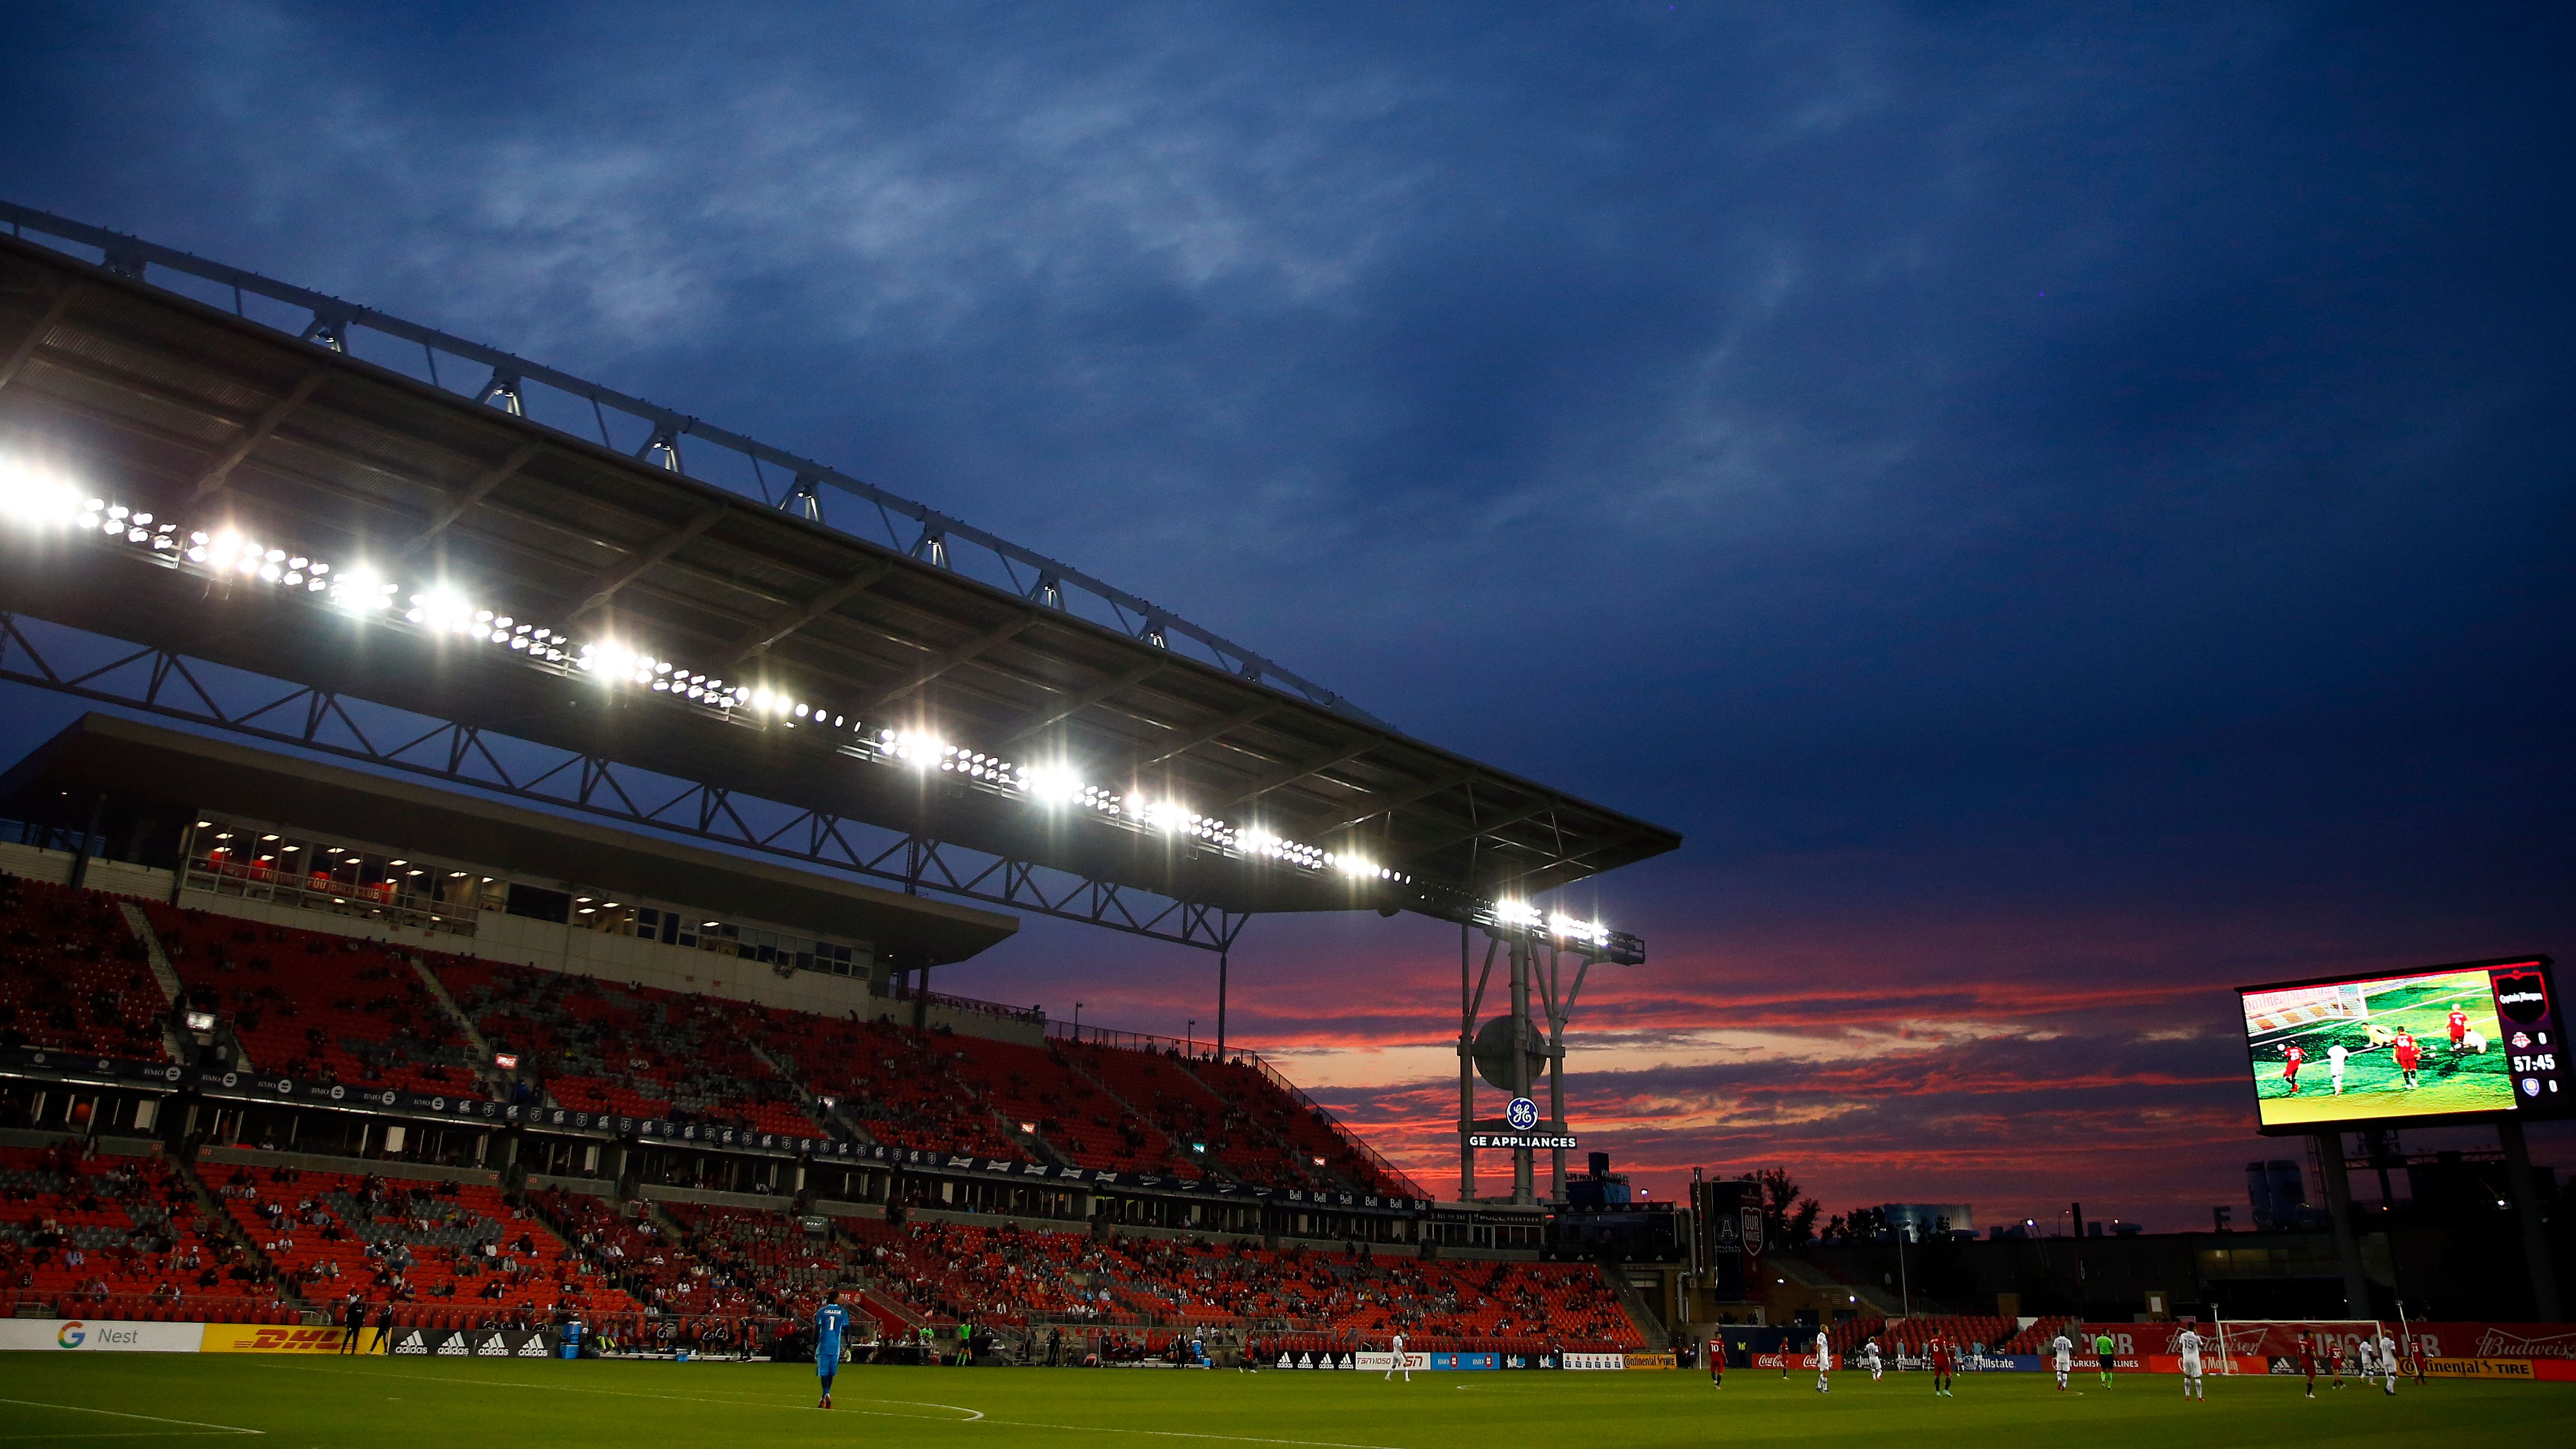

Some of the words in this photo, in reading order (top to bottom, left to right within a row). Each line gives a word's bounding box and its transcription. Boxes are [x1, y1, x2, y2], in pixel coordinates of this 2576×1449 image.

[2538, 1032, 2547, 1045] 0
[2513, 1053, 2555, 1072] 57:45
[144, 1068, 164, 1077] BMO
[258, 1081, 276, 1089] BMO
[2548, 1080, 2558, 1093] 0
[1469, 1136, 1487, 1146] GE
[1492, 1136, 1576, 1148] APPLIANCES
[1289, 1190, 1302, 1200] Bell
[1314, 1192, 1326, 1202] Bell
[1340, 1194, 1352, 1205] Bell
[1365, 1196, 1377, 1206] Bell
[1390, 1199, 1402, 1209] Bell
[1415, 1200, 1426, 1210] Bell
[1745, 1214, 1760, 1231] OUR
[829, 1316, 835, 1330] 1
[98, 1328, 138, 1343] Nest
[251, 1329, 341, 1349] DHL
[1711, 1344, 1719, 1352] 10
[1933, 1343, 1939, 1352] 6
[2184, 1339, 2194, 1349] 15
[2476, 1337, 2570, 1358] Budweis
[395, 1345, 428, 1354] adidas
[438, 1346, 469, 1354] adidas
[478, 1347, 509, 1356] adidas
[518, 1347, 549, 1356] adidas
[1624, 1356, 1656, 1368] Continental
[2495, 1363, 2530, 1374] TIRE
